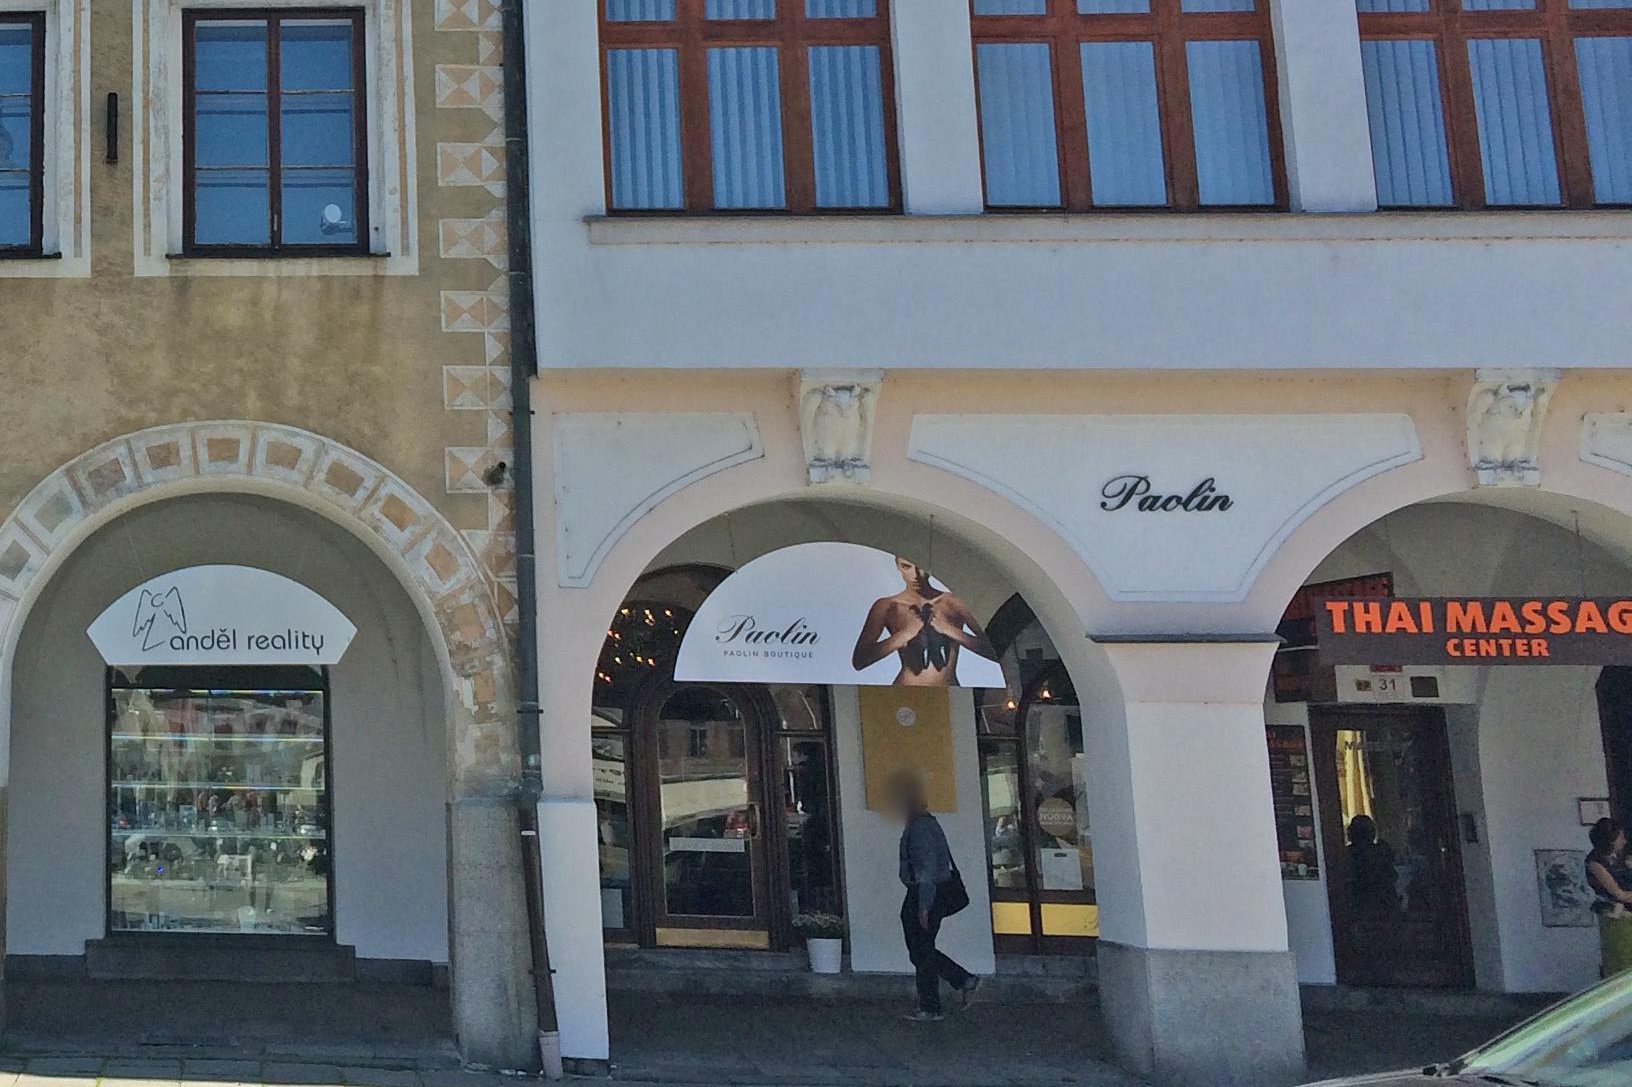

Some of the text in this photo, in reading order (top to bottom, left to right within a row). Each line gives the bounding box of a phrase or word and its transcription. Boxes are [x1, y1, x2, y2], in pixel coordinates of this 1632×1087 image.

[1100, 475, 1235, 512] Paolin
[714, 614, 822, 645] Paolin
[1325, 601, 1435, 634] THAI
[170, 628, 324, 656] anděl reality
[764, 651, 814, 659] BOUTIQUE
[1445, 638, 1550, 657] CENTER
[1379, 678, 1396, 691] 31
